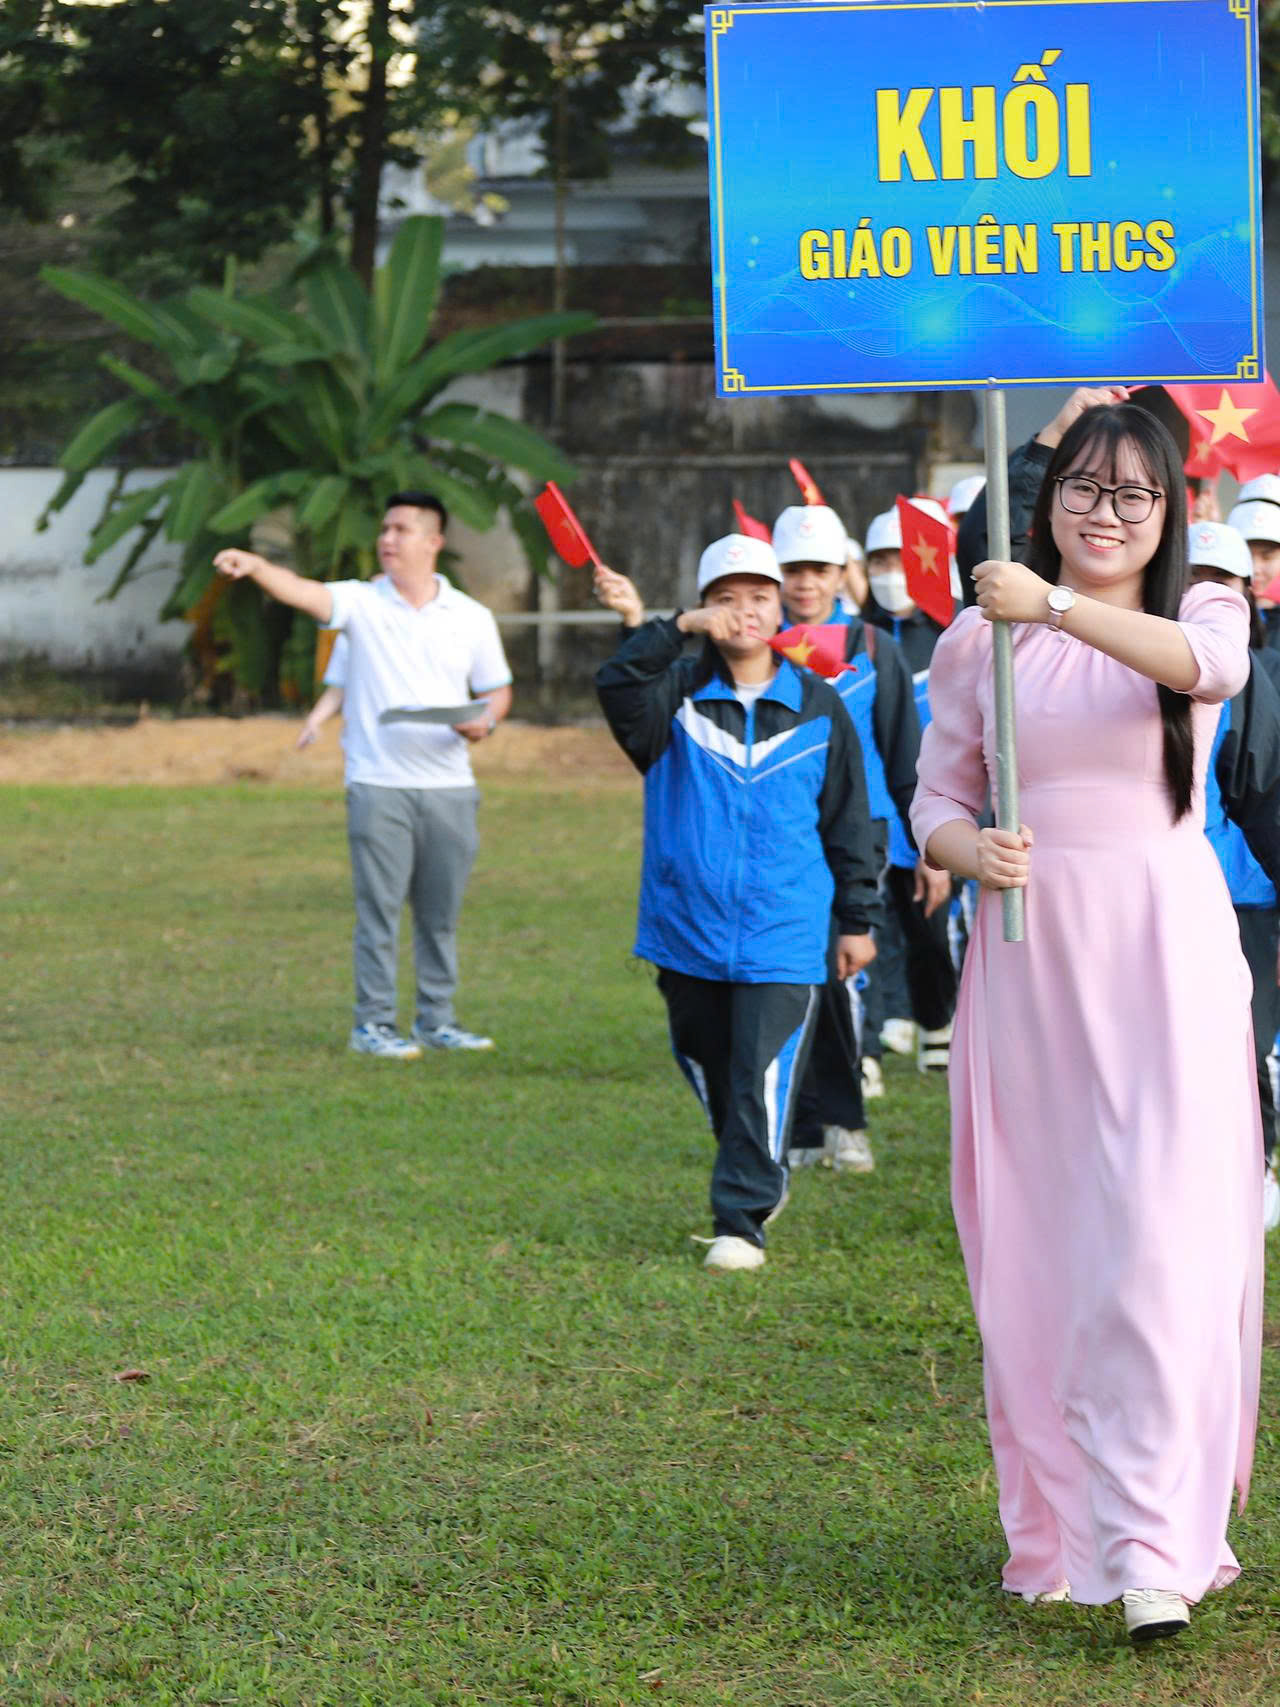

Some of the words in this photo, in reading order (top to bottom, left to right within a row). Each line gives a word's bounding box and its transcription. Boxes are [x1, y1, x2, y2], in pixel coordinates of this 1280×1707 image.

[876, 49, 1092, 182] KHỐI
[799, 217, 912, 280] GIÁO
[927, 214, 1038, 276] VIÊN
[1052, 220, 1177, 273] THCS
